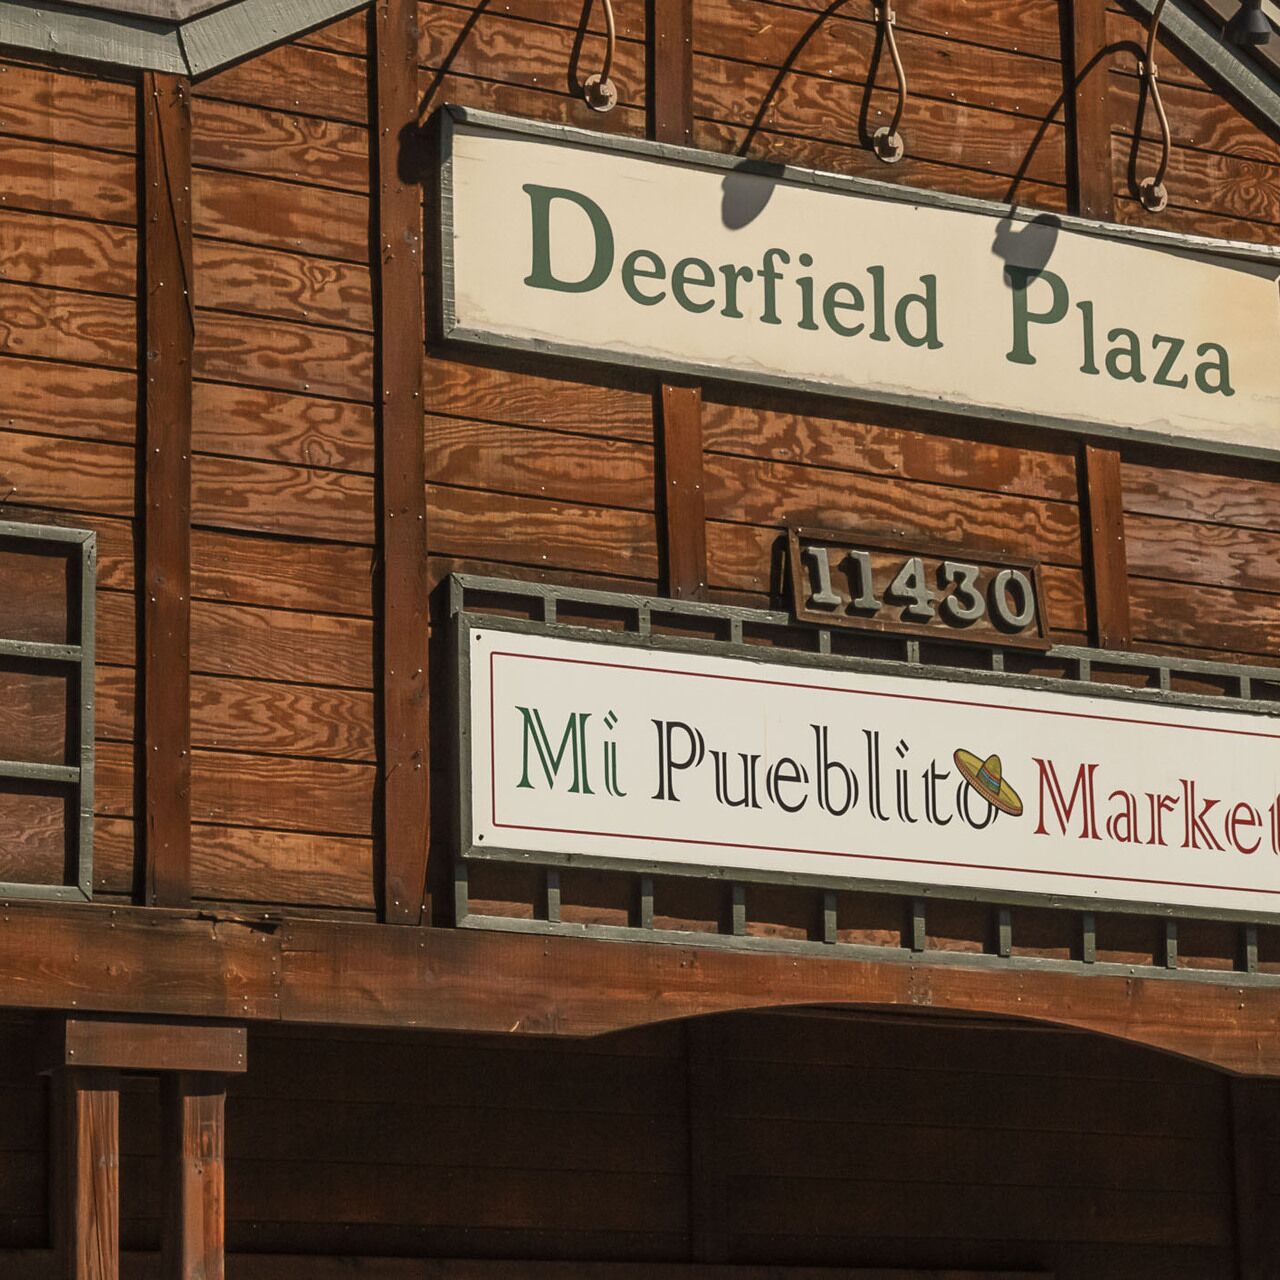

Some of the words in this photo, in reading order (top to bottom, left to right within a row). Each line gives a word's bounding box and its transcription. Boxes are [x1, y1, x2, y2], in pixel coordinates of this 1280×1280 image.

[521, 182, 944, 351] Deerfield
[1004, 263, 1236, 397] Plaza
[805, 546, 1037, 632] 11430
[514, 705, 627, 799] Mi
[650, 718, 1001, 830] Pueblito
